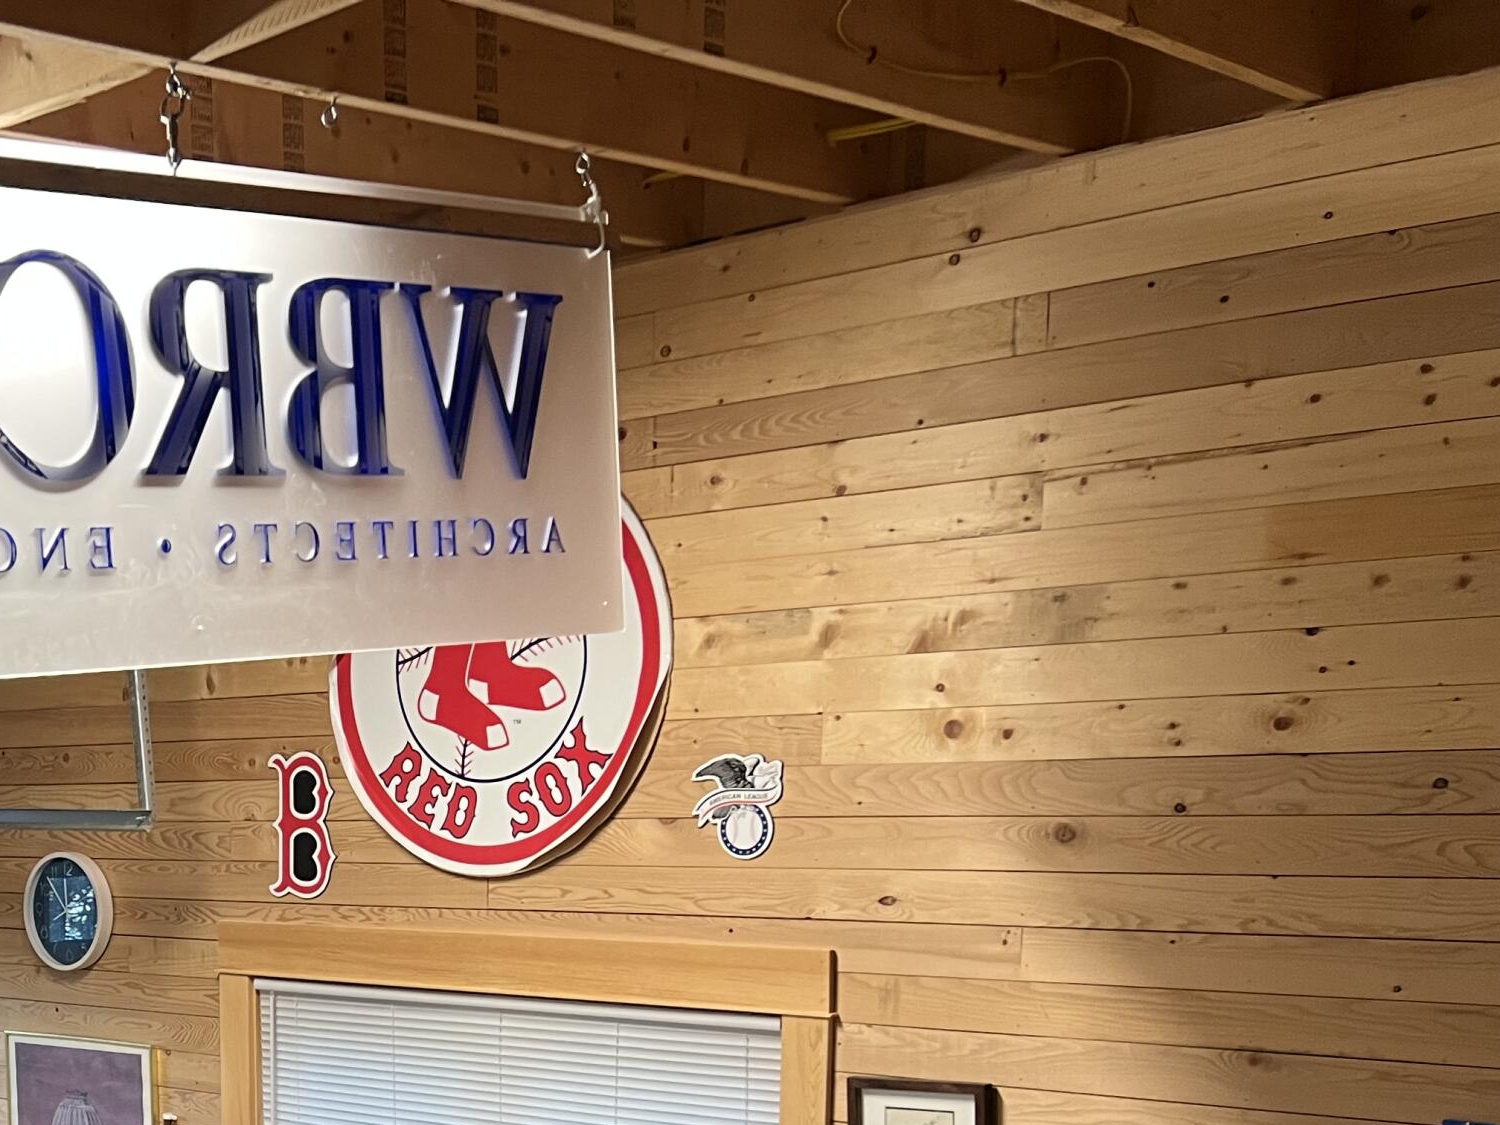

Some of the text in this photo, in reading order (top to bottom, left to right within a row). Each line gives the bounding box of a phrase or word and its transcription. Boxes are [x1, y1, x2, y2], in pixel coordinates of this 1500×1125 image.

[271, 753, 336, 896] B
[379, 715, 613, 839] RED SOX
